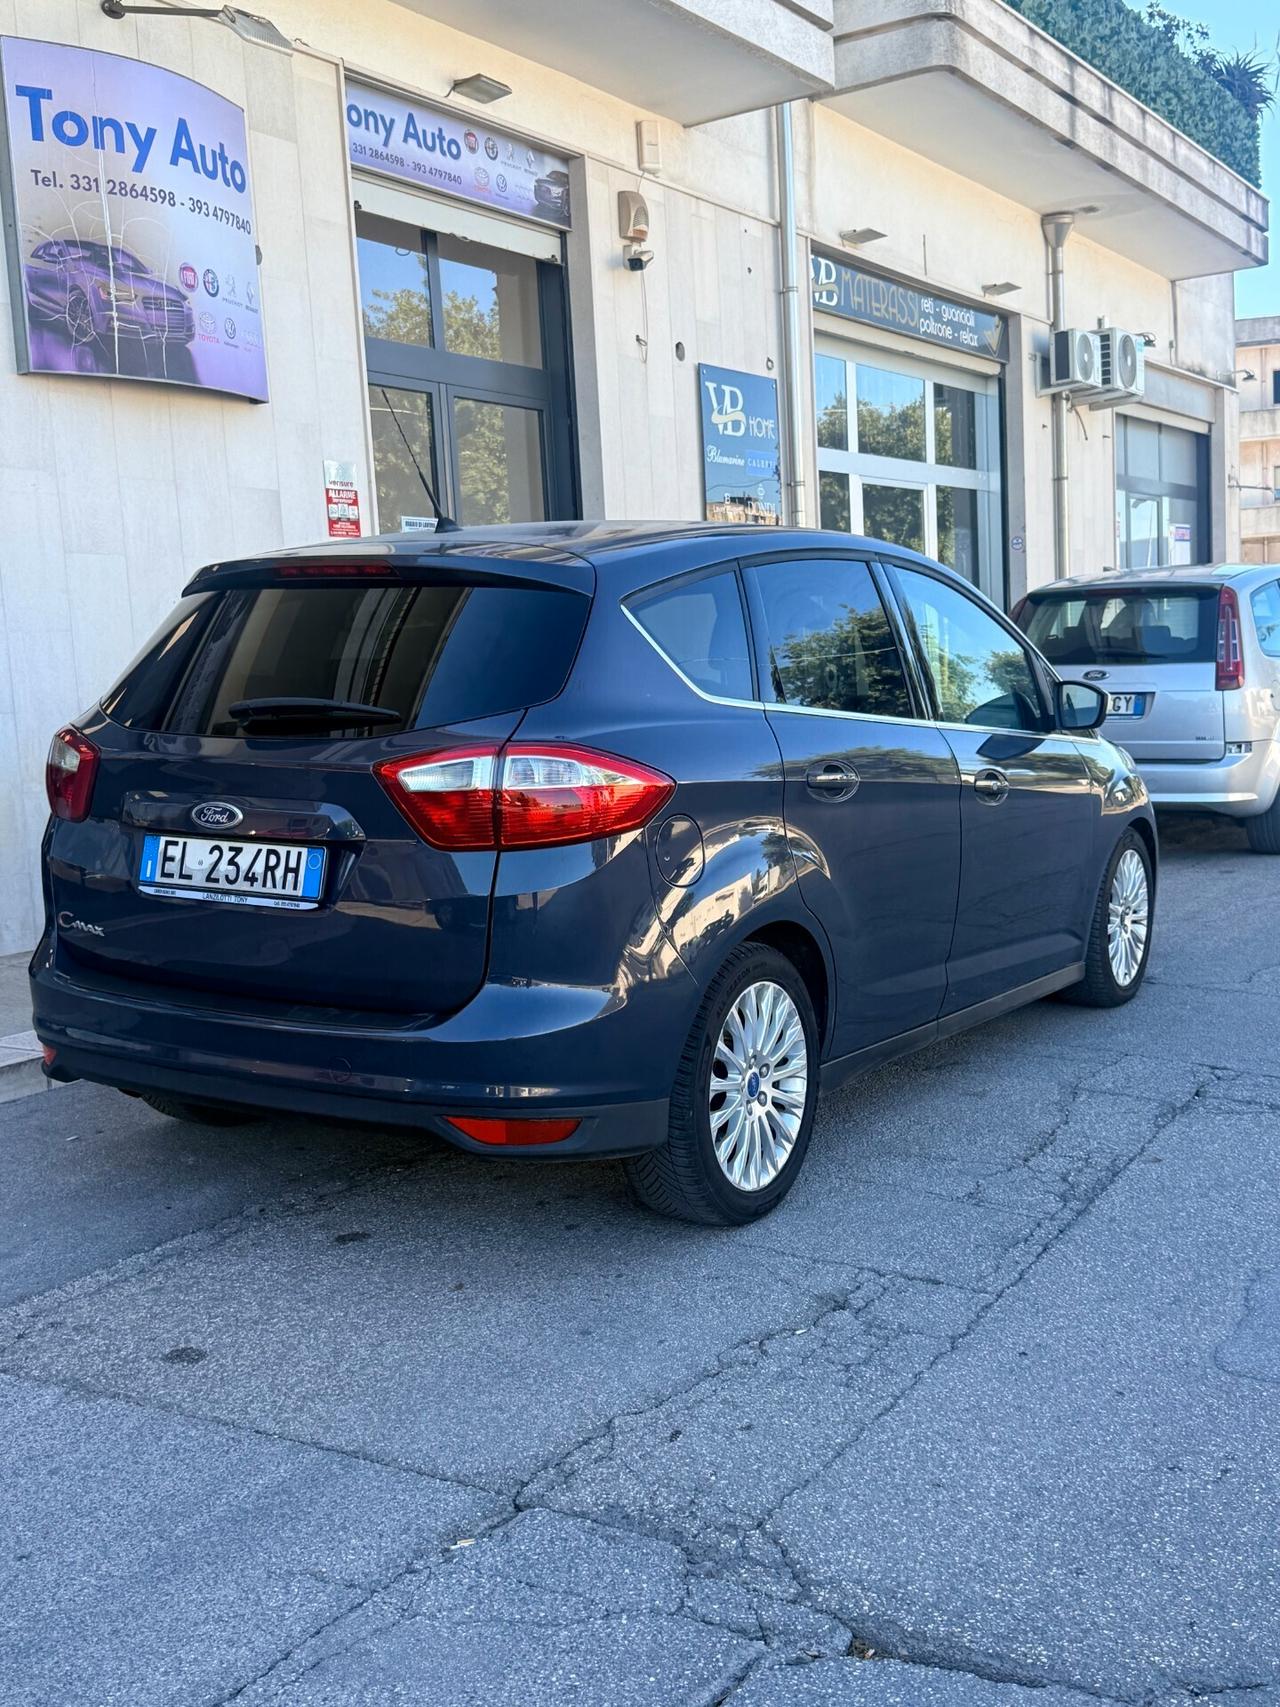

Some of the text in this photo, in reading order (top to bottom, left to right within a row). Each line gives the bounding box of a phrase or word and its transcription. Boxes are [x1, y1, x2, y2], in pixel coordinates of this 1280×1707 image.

[15, 85, 247, 194] Tony Auto
[347, 103, 462, 161] ony Auto
[352, 142, 368, 156] 331
[369, 145, 405, 168] 2864598
[411, 161, 427, 175] 393
[428, 165, 462, 186] 4797840
[30, 169, 64, 190] Tel.
[70, 174, 99, 194] 331
[107, 178, 177, 208] 2864598
[188, 199, 210, 219] 393
[212, 207, 252, 236] 4797840
[841, 268, 919, 330] MATERASSI
[920, 297, 934, 313] reti
[941, 306, 976, 328] guanciali
[919, 316, 953, 341] poltrone
[959, 330, 979, 348] relax
[749, 416, 775, 440] HOME
[329, 479, 354, 488] verisure
[200, 805, 229, 823] Ford
[160, 840, 193, 881] EL
[205, 844, 302, 891] 234RH
